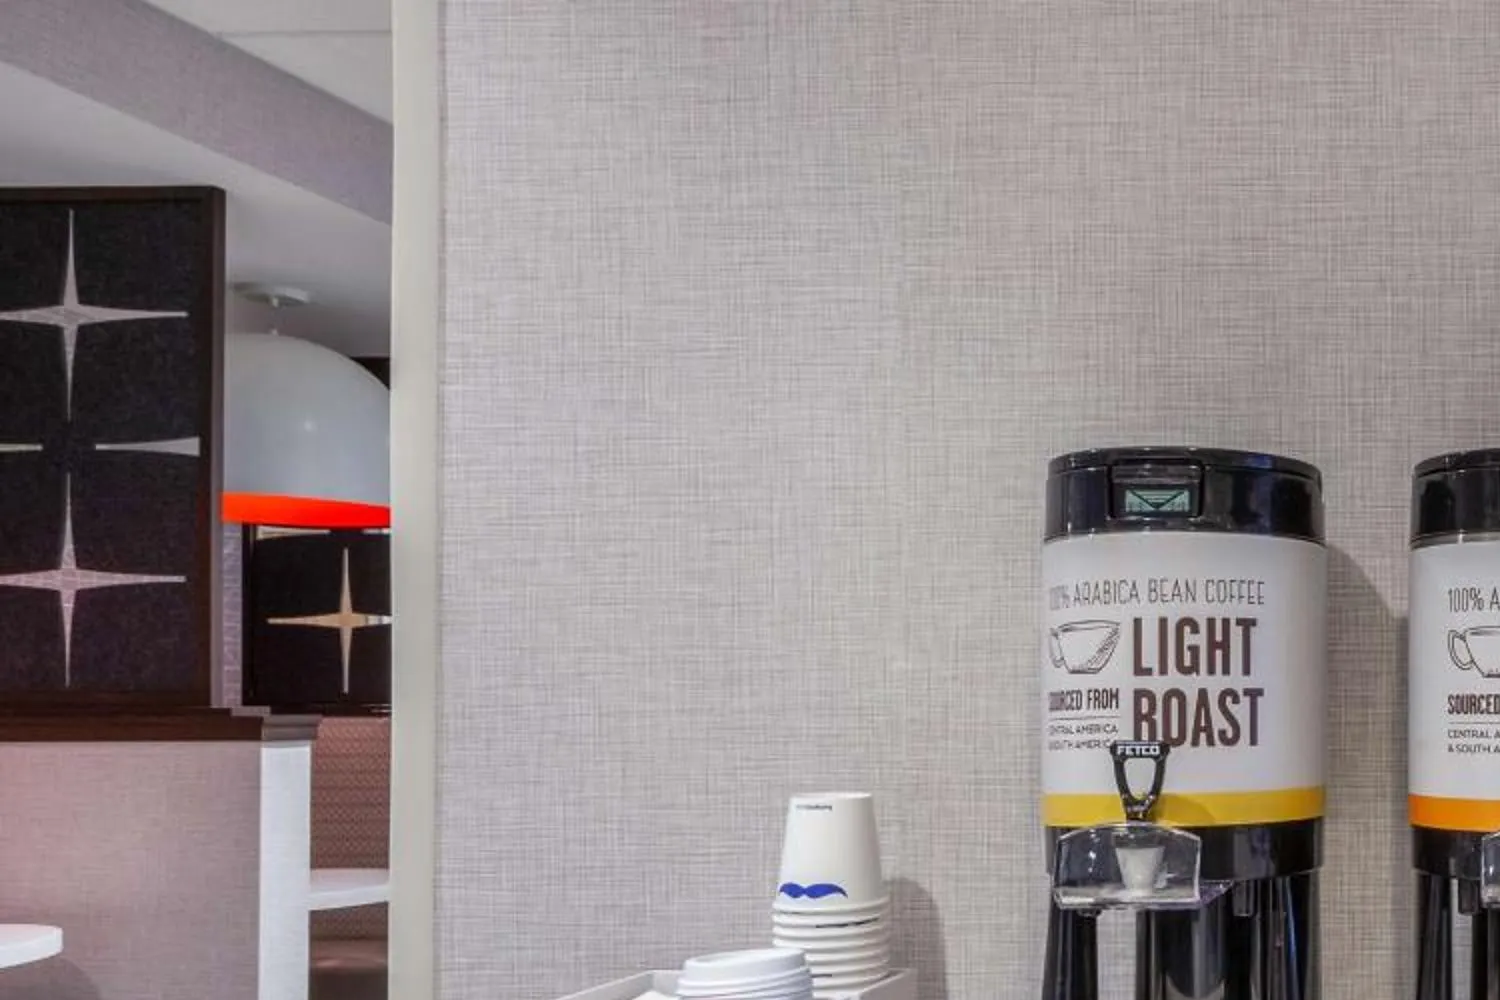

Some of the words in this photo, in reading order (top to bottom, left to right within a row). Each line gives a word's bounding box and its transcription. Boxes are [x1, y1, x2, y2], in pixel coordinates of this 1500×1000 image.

[1073, 579, 1140, 607] ARABICA
[1149, 578, 1196, 603] BEAN
[1206, 579, 1265, 605] COFFEE
[1447, 587, 1484, 613] 100%
[1133, 616, 1257, 677] LIGHT
[1087, 687, 1120, 711] FROM
[1133, 687, 1265, 748] ROAST
[1117, 745, 1161, 756] FETCO
